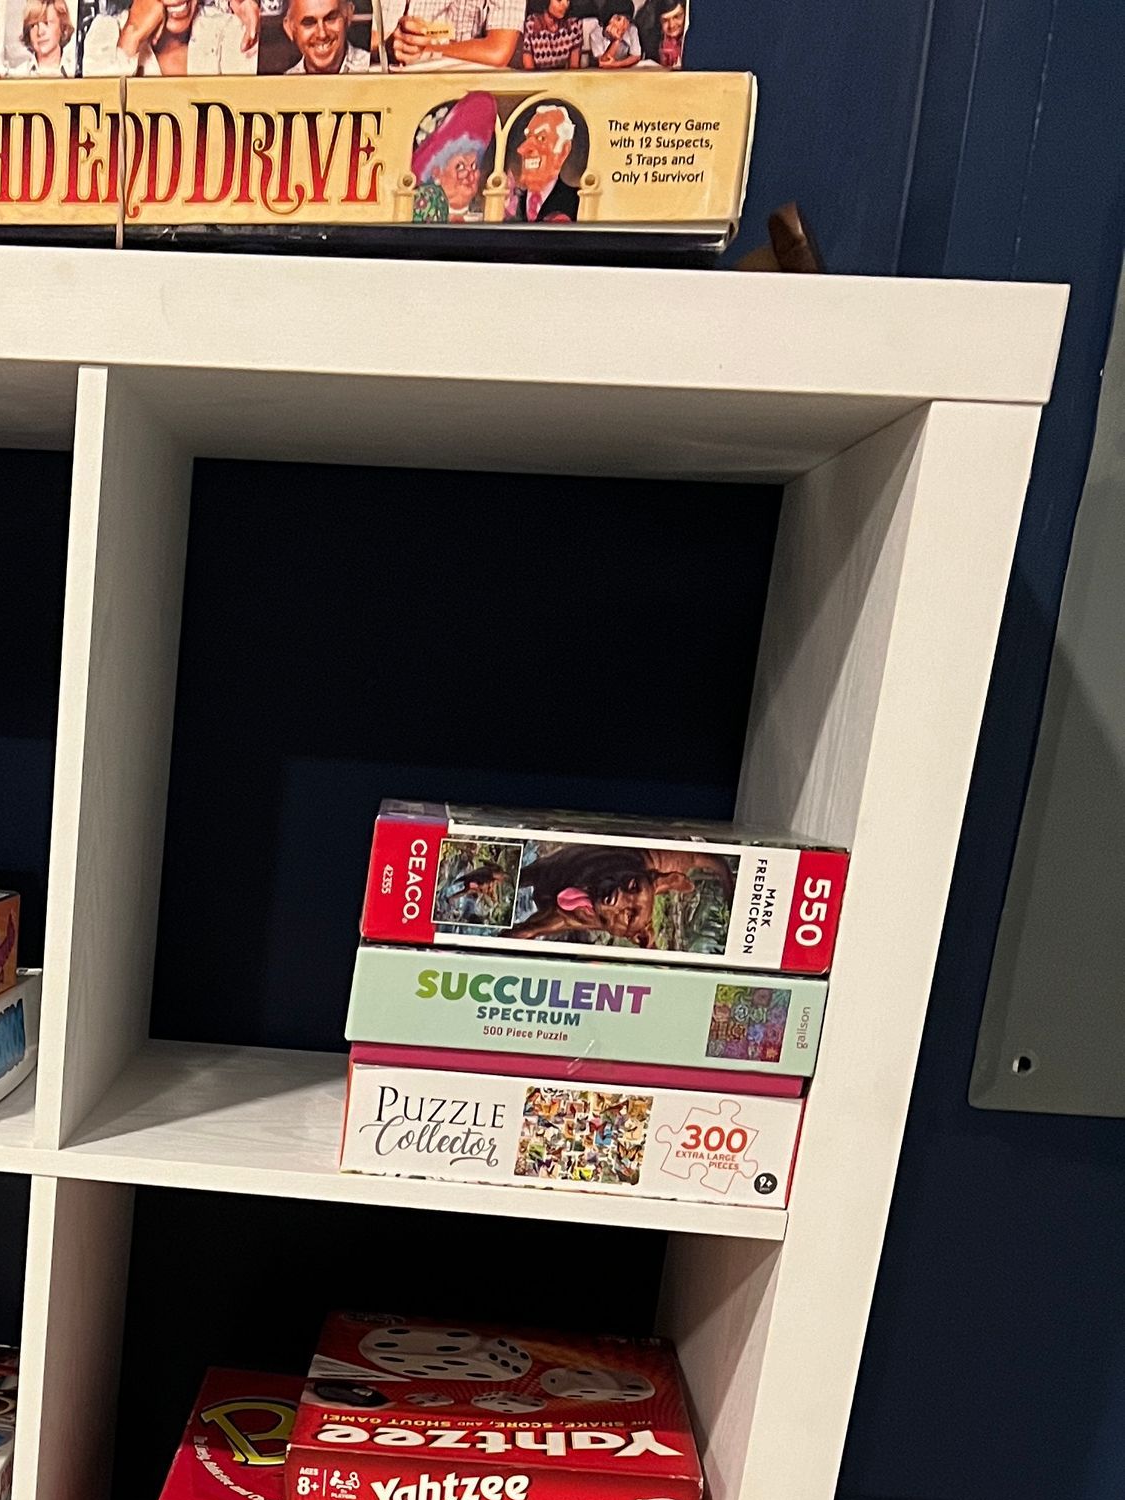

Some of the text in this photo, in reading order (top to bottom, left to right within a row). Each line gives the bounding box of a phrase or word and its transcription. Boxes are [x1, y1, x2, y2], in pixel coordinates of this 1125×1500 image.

[608, 119, 720, 134] The Mystery Game
[610, 136, 714, 150] with 12 Suspects,
[191, 101, 385, 215] DRIVE
[625, 154, 695, 168] 5 Traps and
[611, 171, 641, 185] Only
[380, 863, 394, 895] 42355
[402, 838, 429, 920] CEACO
[742, 857, 769, 955] FREDRICKSON
[761, 887, 777, 928] MARK
[794, 876, 832, 948] 550
[415, 969, 652, 1015] SUCCULENT
[476, 1005, 581, 1027] SPECTRUM
[796, 1006, 812, 1050] galison
[482, 1025, 569, 1042] 500 Piece Puzzle
[358, 1113, 500, 1168] Collector
[680, 1124, 749, 1154] 300
[675, 1150, 738, 1163] EXTRA LARGE
[708, 1161, 740, 1171] PIECES
[386, 1417, 453, 1428] SHOUT
[316, 1423, 685, 1457] Yahtzee
[299, 1466, 319, 1477] AGES
[296, 1475, 320, 1496] 8+
